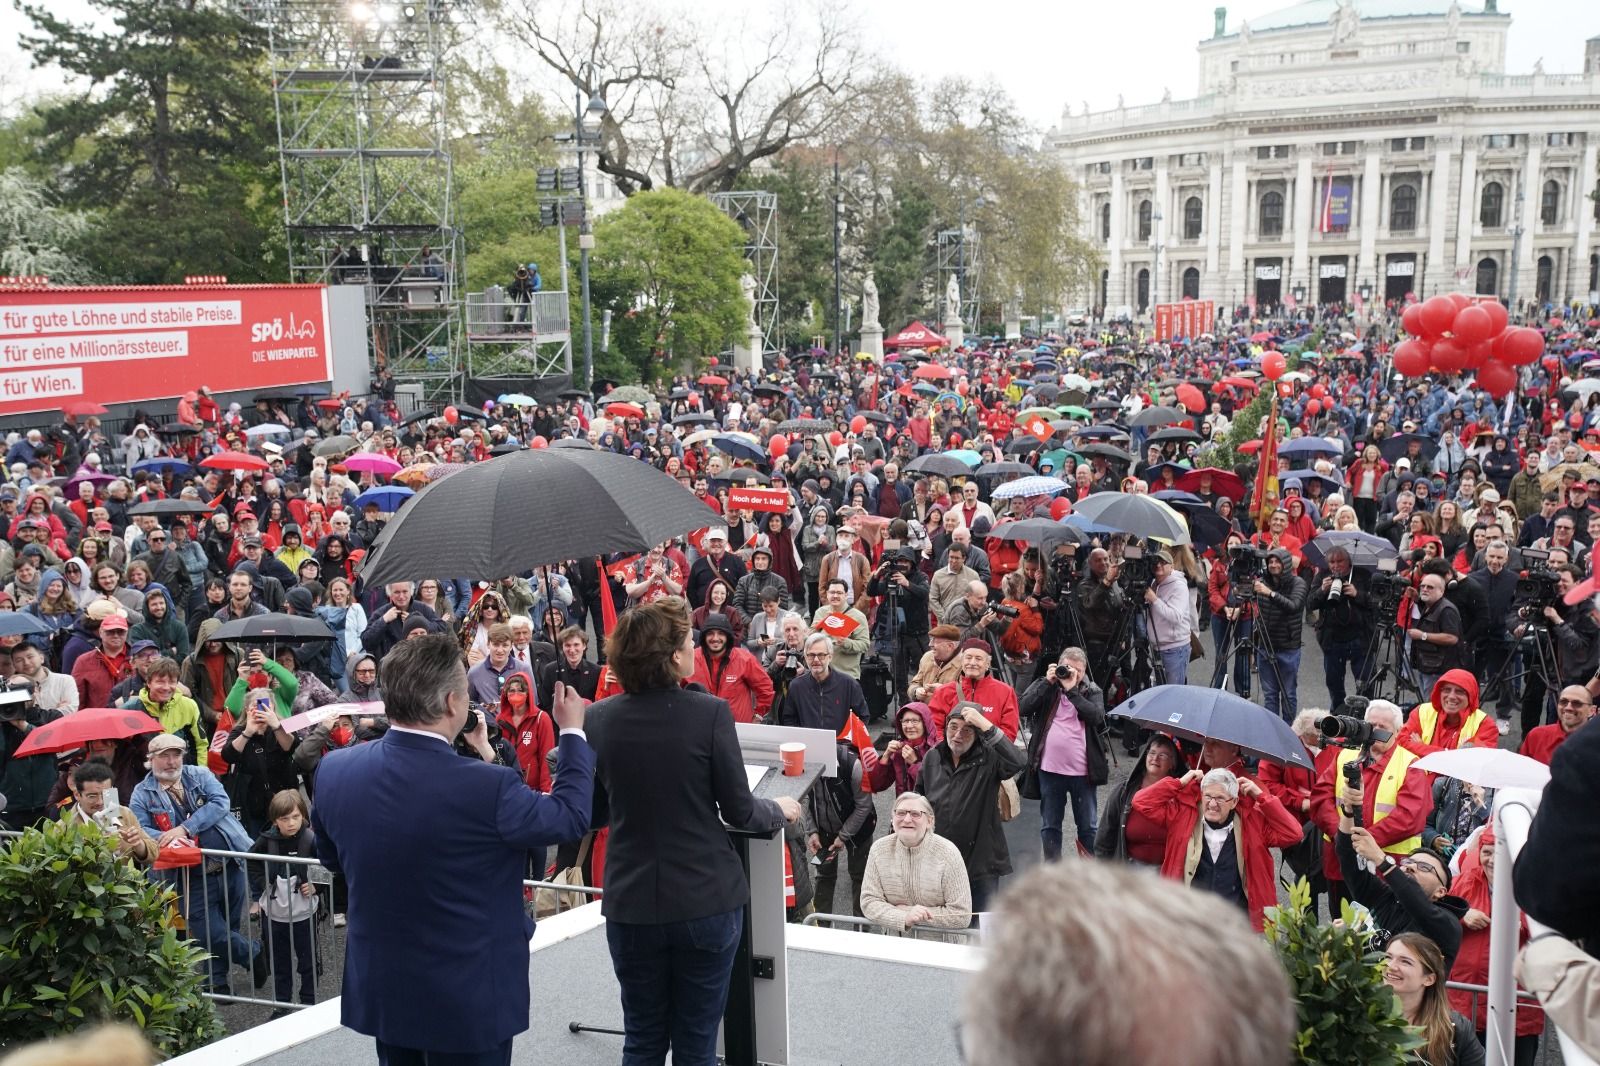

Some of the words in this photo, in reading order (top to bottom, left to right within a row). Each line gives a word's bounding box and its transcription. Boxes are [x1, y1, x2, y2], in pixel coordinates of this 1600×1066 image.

[4, 312, 28, 329] für
[33, 312, 68, 333] gute
[72, 309, 117, 326] Löhne
[121, 308, 147, 324] und
[151, 306, 193, 324] stabile
[196, 305, 237, 321] Preise.
[251, 318, 283, 342] SPÖ
[897, 331, 926, 340] SPÖ
[4, 345, 28, 362] für
[33, 343, 65, 360] eine
[70, 339, 183, 358] Millionärssteuer.
[252, 350, 266, 362] DIE
[266, 346, 319, 361] WIENPARTEI.
[3, 378, 28, 395] für
[31, 375, 76, 393] Wien.
[732, 495, 750, 503] Hoch
[750, 496, 763, 504] der
[763, 497, 769, 505] 1.
